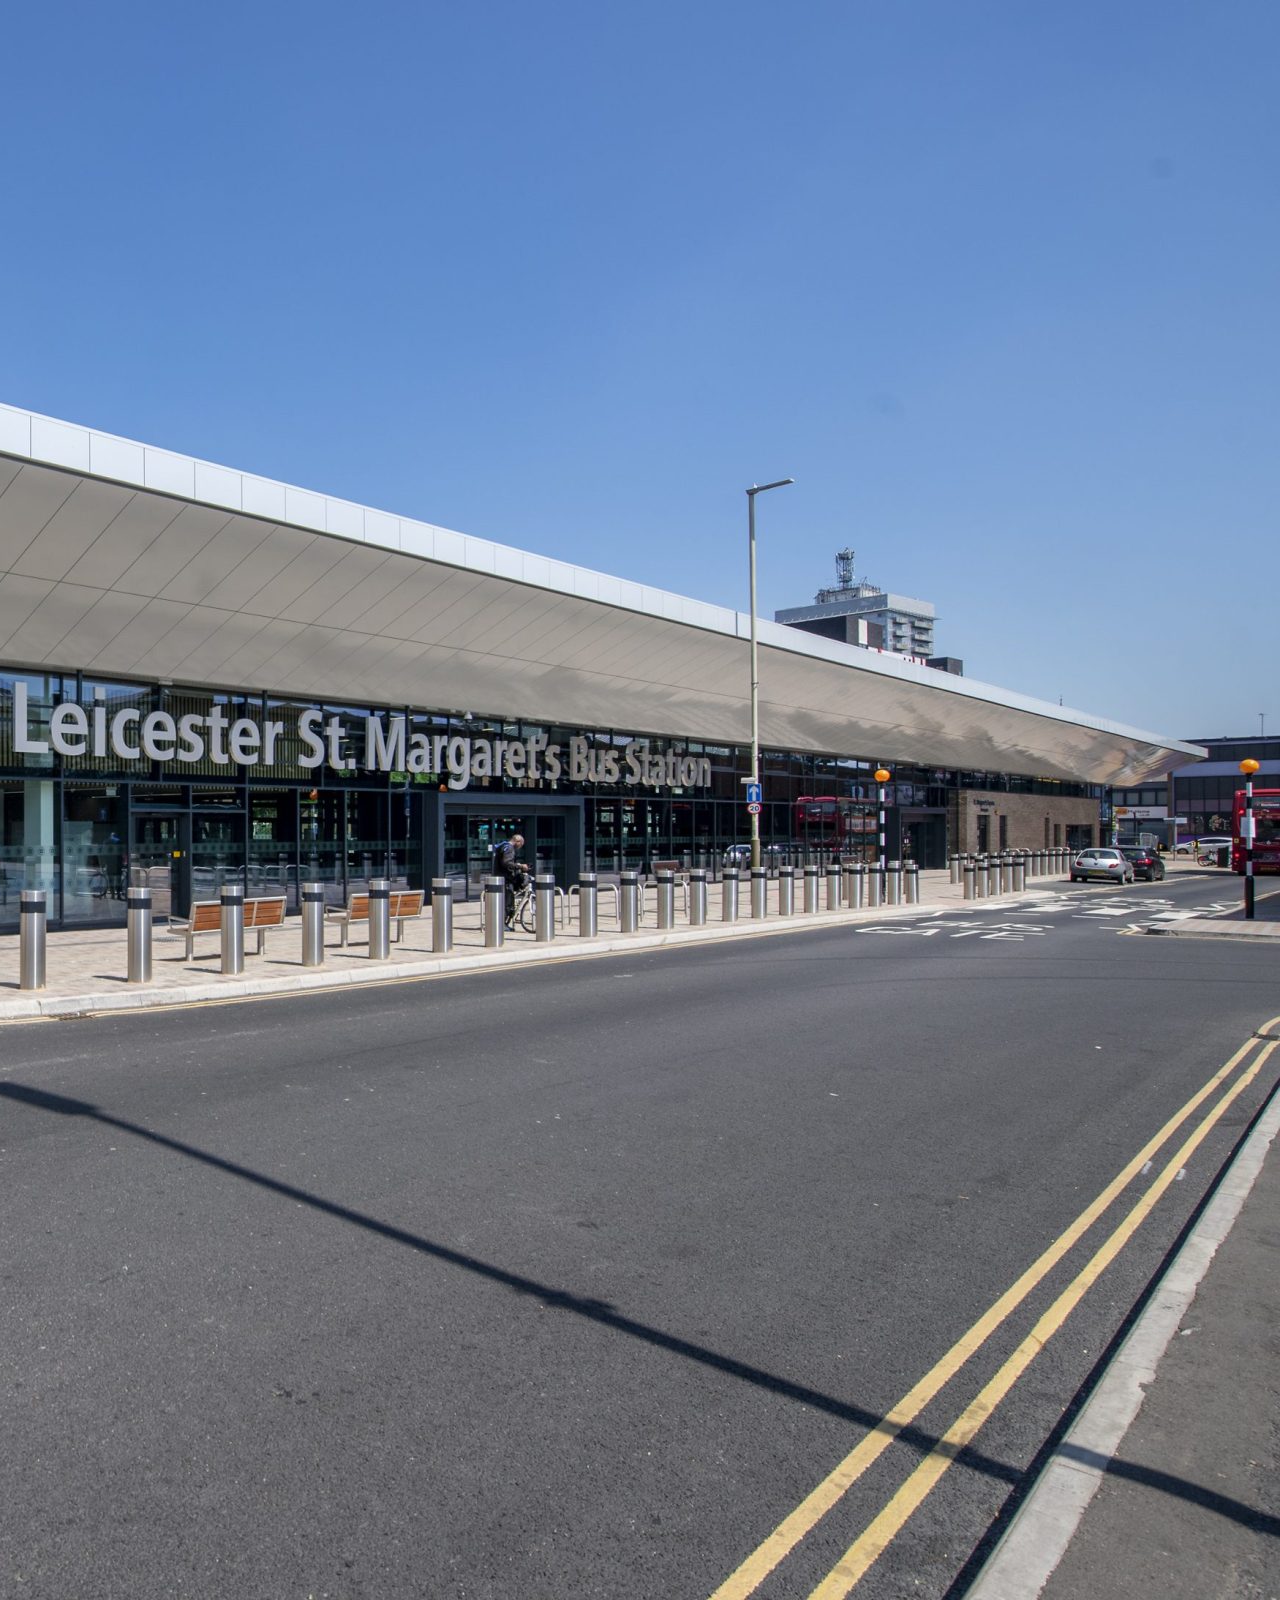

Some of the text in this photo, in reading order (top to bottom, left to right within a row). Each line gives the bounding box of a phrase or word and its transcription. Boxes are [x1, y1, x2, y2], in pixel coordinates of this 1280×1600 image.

[13, 681, 711, 790] Leicester St. Margaret's Bus Station
[856, 926, 1046, 941] GATE
[916, 921, 1055, 931] BUS
